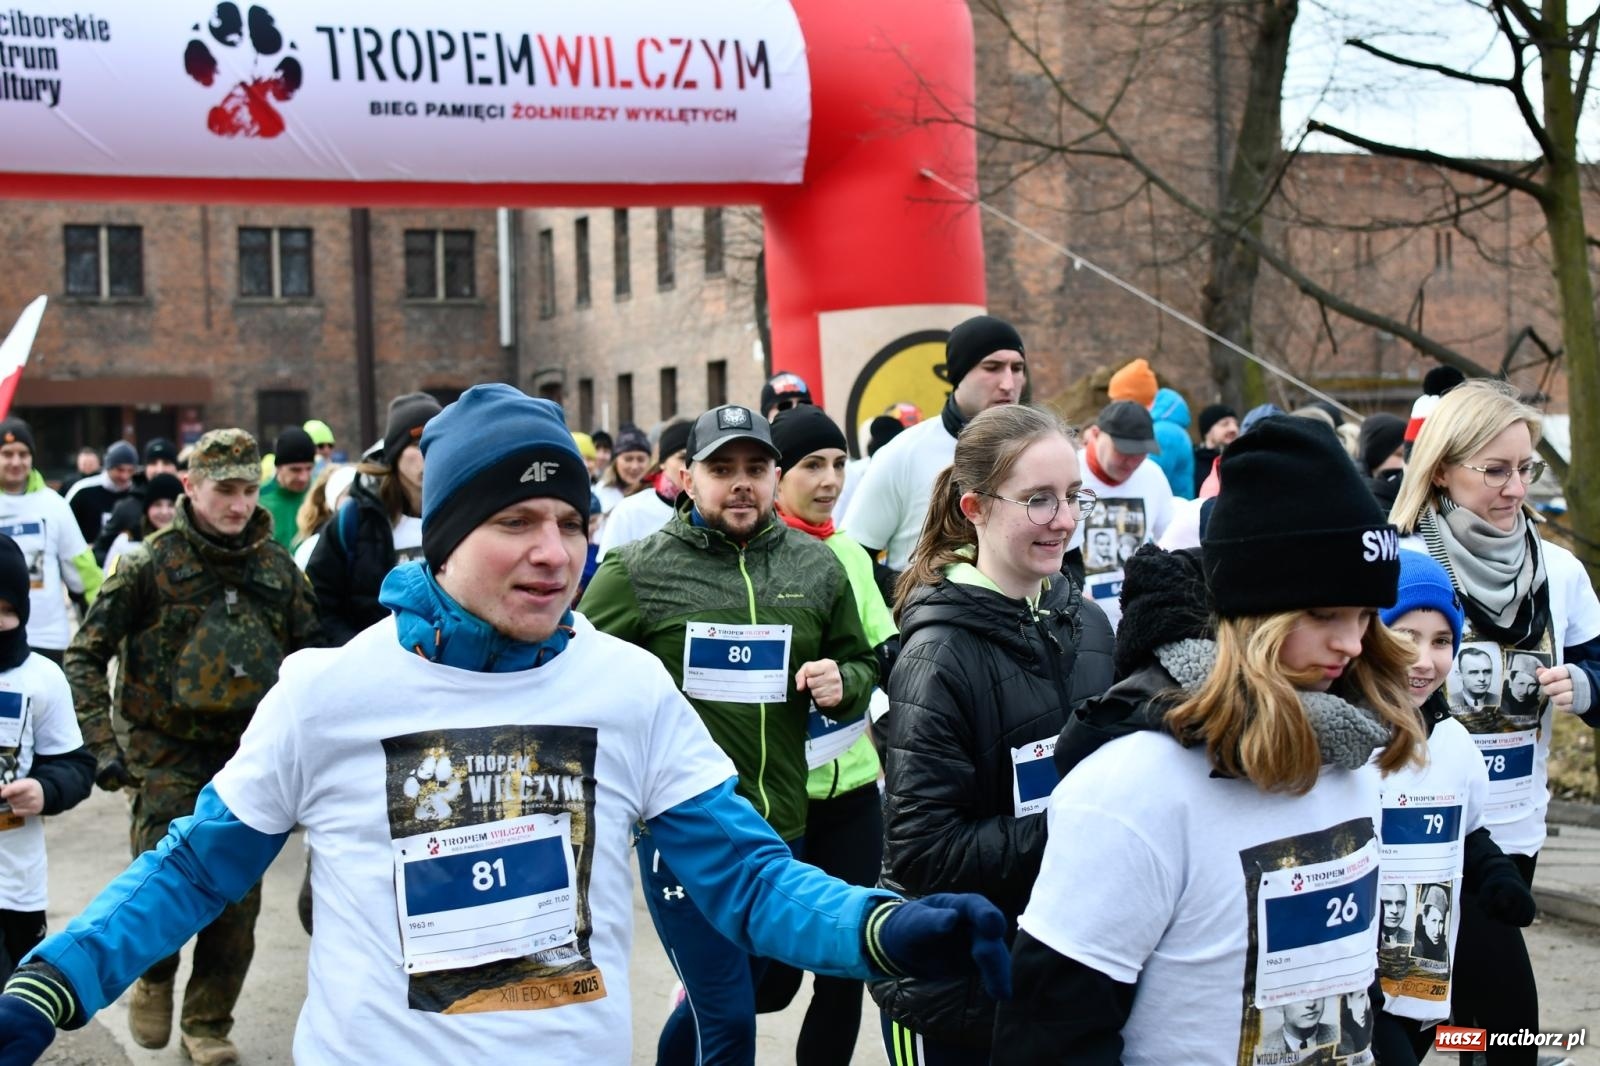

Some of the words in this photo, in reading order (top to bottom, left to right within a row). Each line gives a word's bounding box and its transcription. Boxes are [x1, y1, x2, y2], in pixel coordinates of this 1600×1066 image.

[0, 9, 110, 41] ciborskie
[0, 71, 61, 108] ltury
[370, 101, 418, 116] BIEG
[425, 103, 504, 122] PAMIĘCI
[512, 102, 618, 121] ŻOŁNIERZY
[625, 107, 737, 126] WYKLĘTYCH
[728, 645, 752, 663] 80
[465, 755, 531, 774] TROPEM
[1483, 755, 1506, 773] 78
[468, 774, 585, 804] WILCZYM
[442, 832, 488, 847] TROPEM
[490, 824, 536, 840] WILCZYM
[1423, 813, 1444, 835] 79
[471, 858, 507, 891] 81
[1306, 868, 1345, 883] TROPEM
[1326, 892, 1359, 928] 26
[409, 920, 426, 930] 1963
[1266, 957, 1283, 966] 1963
[500, 986, 518, 1004] XIII
[522, 984, 570, 1003] EDYCJA
[573, 975, 599, 995] 2025
